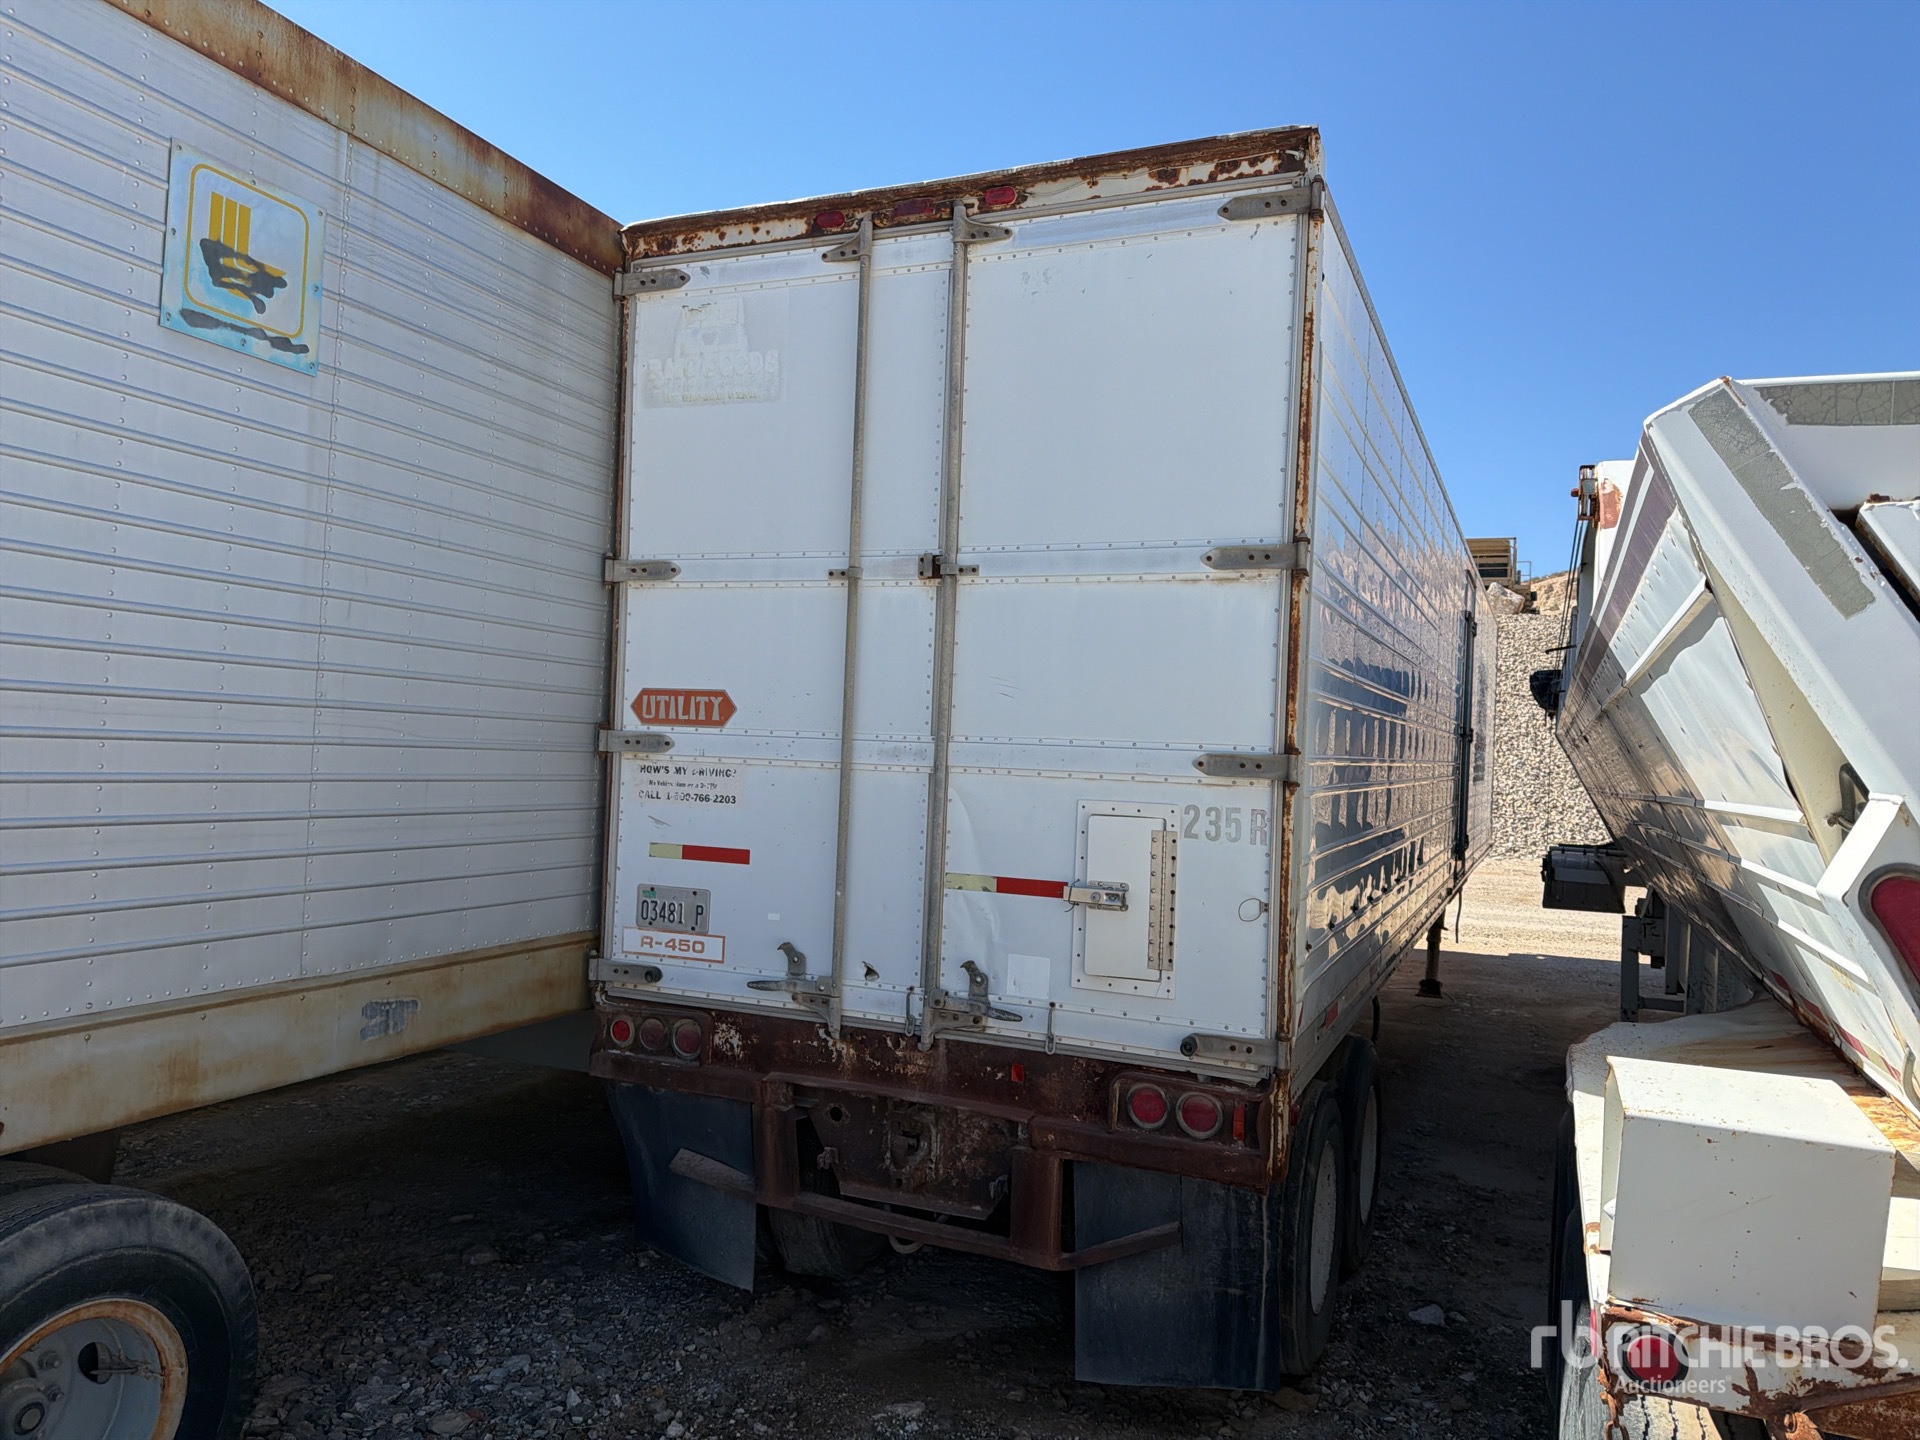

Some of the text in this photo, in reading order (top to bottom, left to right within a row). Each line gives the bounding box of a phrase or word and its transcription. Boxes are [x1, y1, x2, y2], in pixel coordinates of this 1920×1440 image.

[641, 695, 724, 721] UTILITY
[640, 764, 670, 775] HOW'S
[673, 766, 688, 776] MY
[1183, 804, 1268, 846] 235 R
[640, 899, 704, 926] 03481 P
[640, 935, 706, 954] R-450
